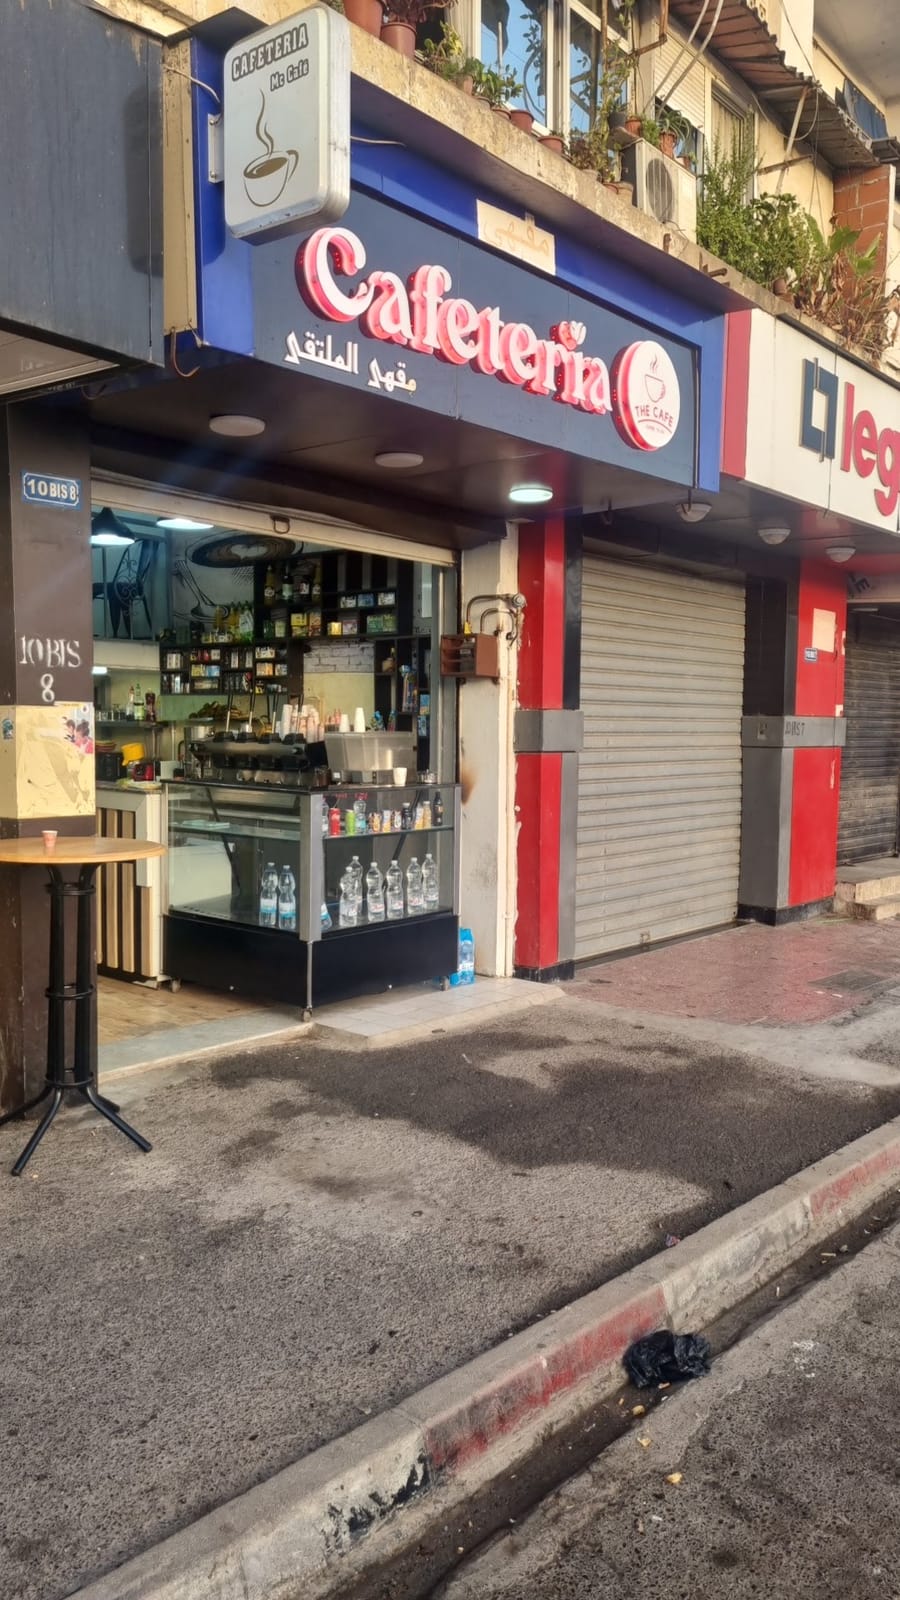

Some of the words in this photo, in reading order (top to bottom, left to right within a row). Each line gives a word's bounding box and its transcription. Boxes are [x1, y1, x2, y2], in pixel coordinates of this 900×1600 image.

[231, 23, 309, 82] CAFETERIA
[270, 71, 285, 92] Mc
[286, 58, 309, 83] Café
[296, 227, 613, 415] Cafeteria
[635, 404, 650, 417] THE
[652, 405, 674, 428] CAFE
[70, 485, 76, 500] 8
[40, 673, 55, 702] 8
